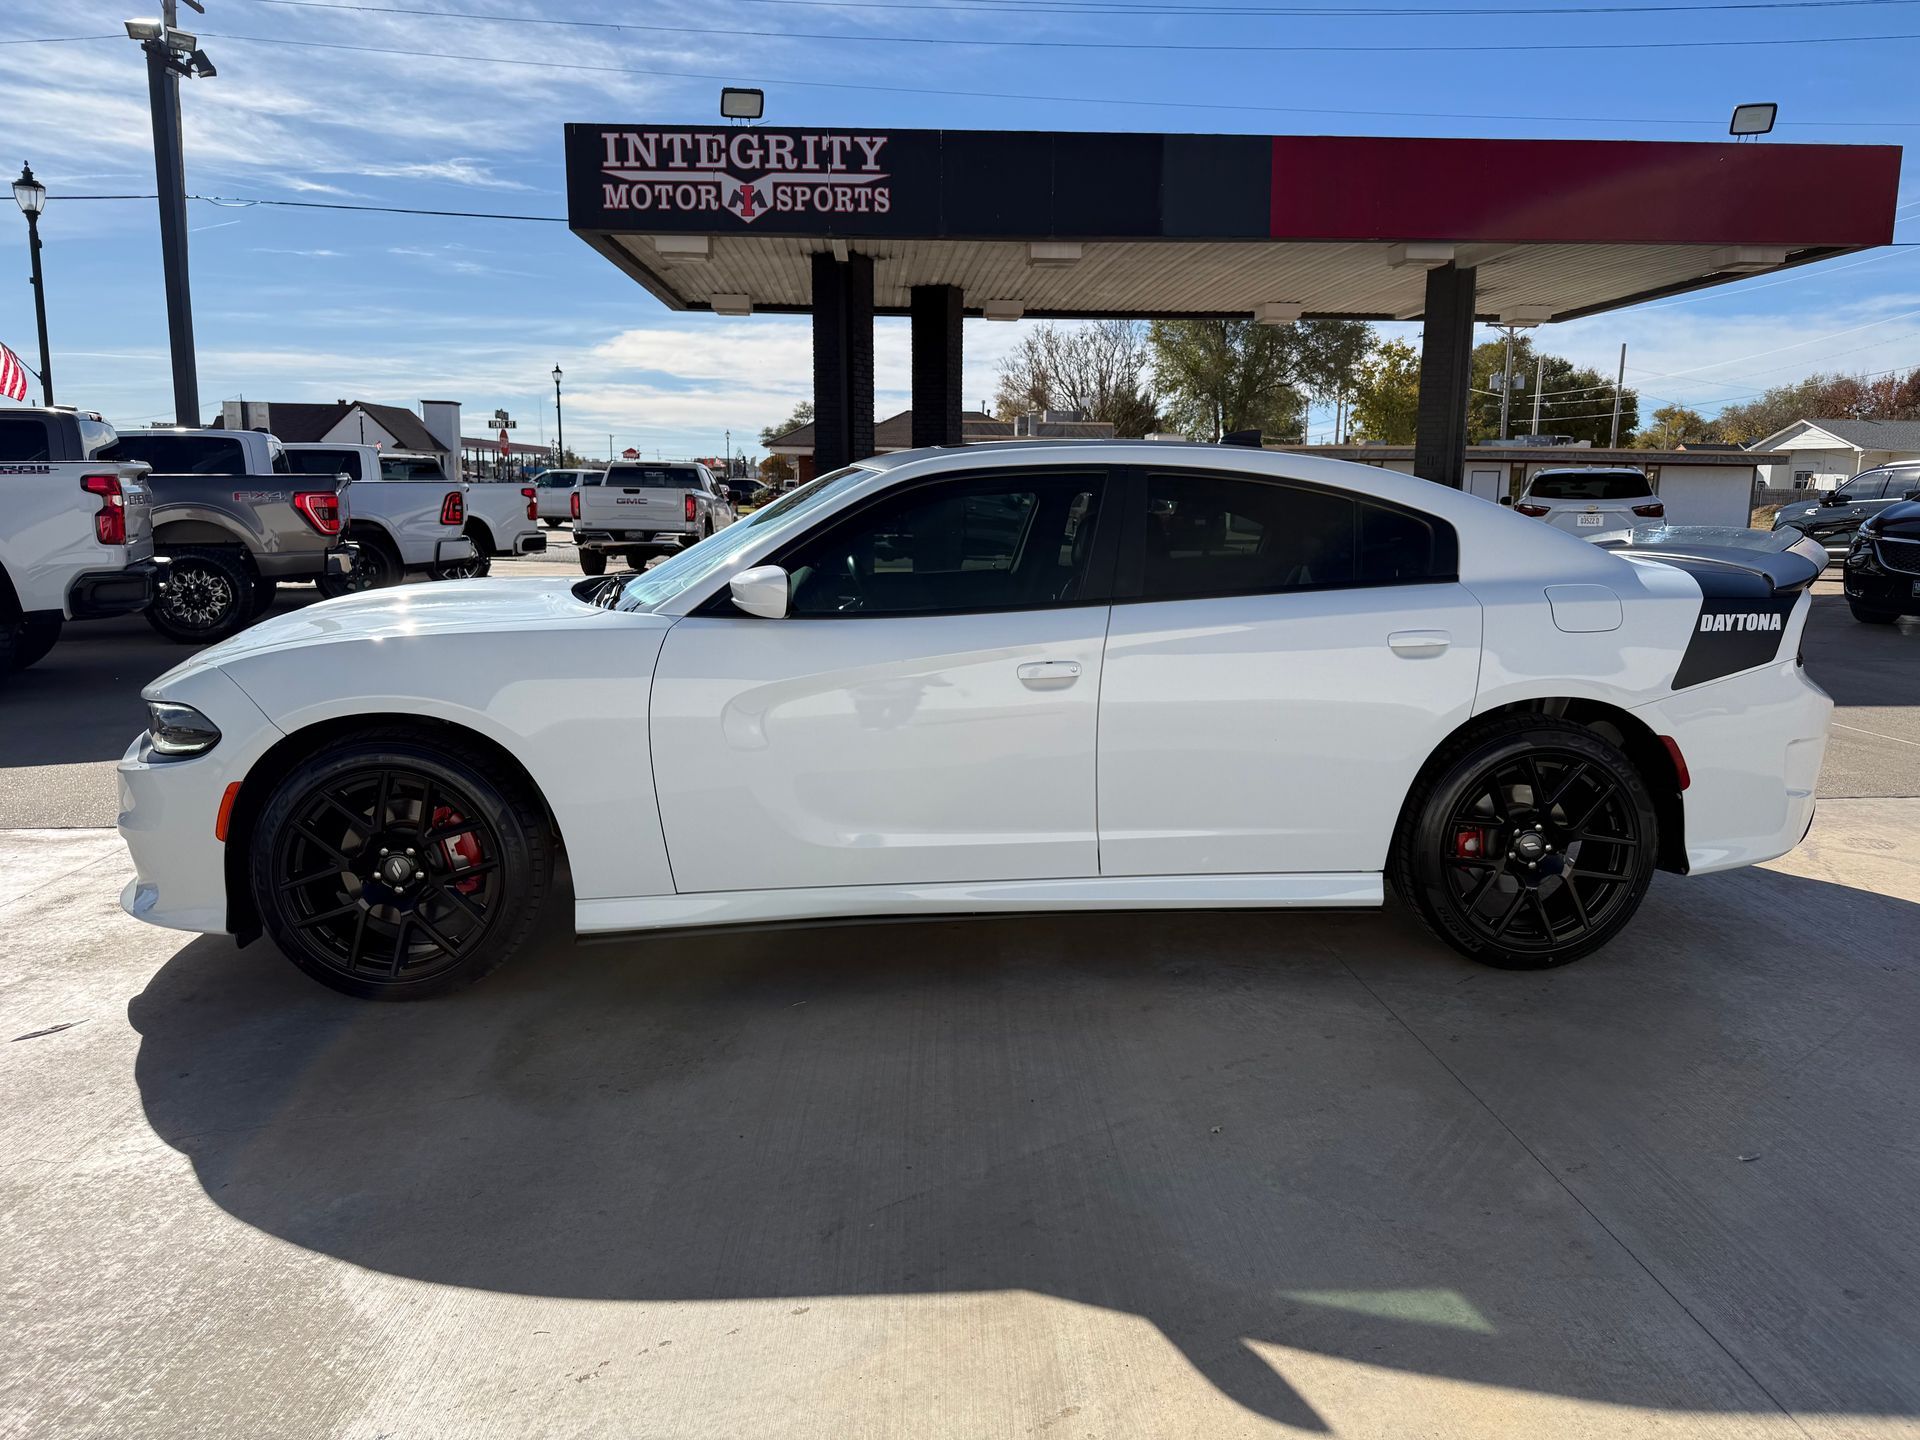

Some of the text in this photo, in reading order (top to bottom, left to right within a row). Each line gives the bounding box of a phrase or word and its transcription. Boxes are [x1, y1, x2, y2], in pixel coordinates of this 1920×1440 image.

[601, 132, 888, 170] INTEGRITY
[602, 184, 720, 210] MOTOR
[776, 186, 891, 213] SPORTS
[232, 490, 286, 502] FX4
[1700, 613, 1781, 632] DAYTONA
